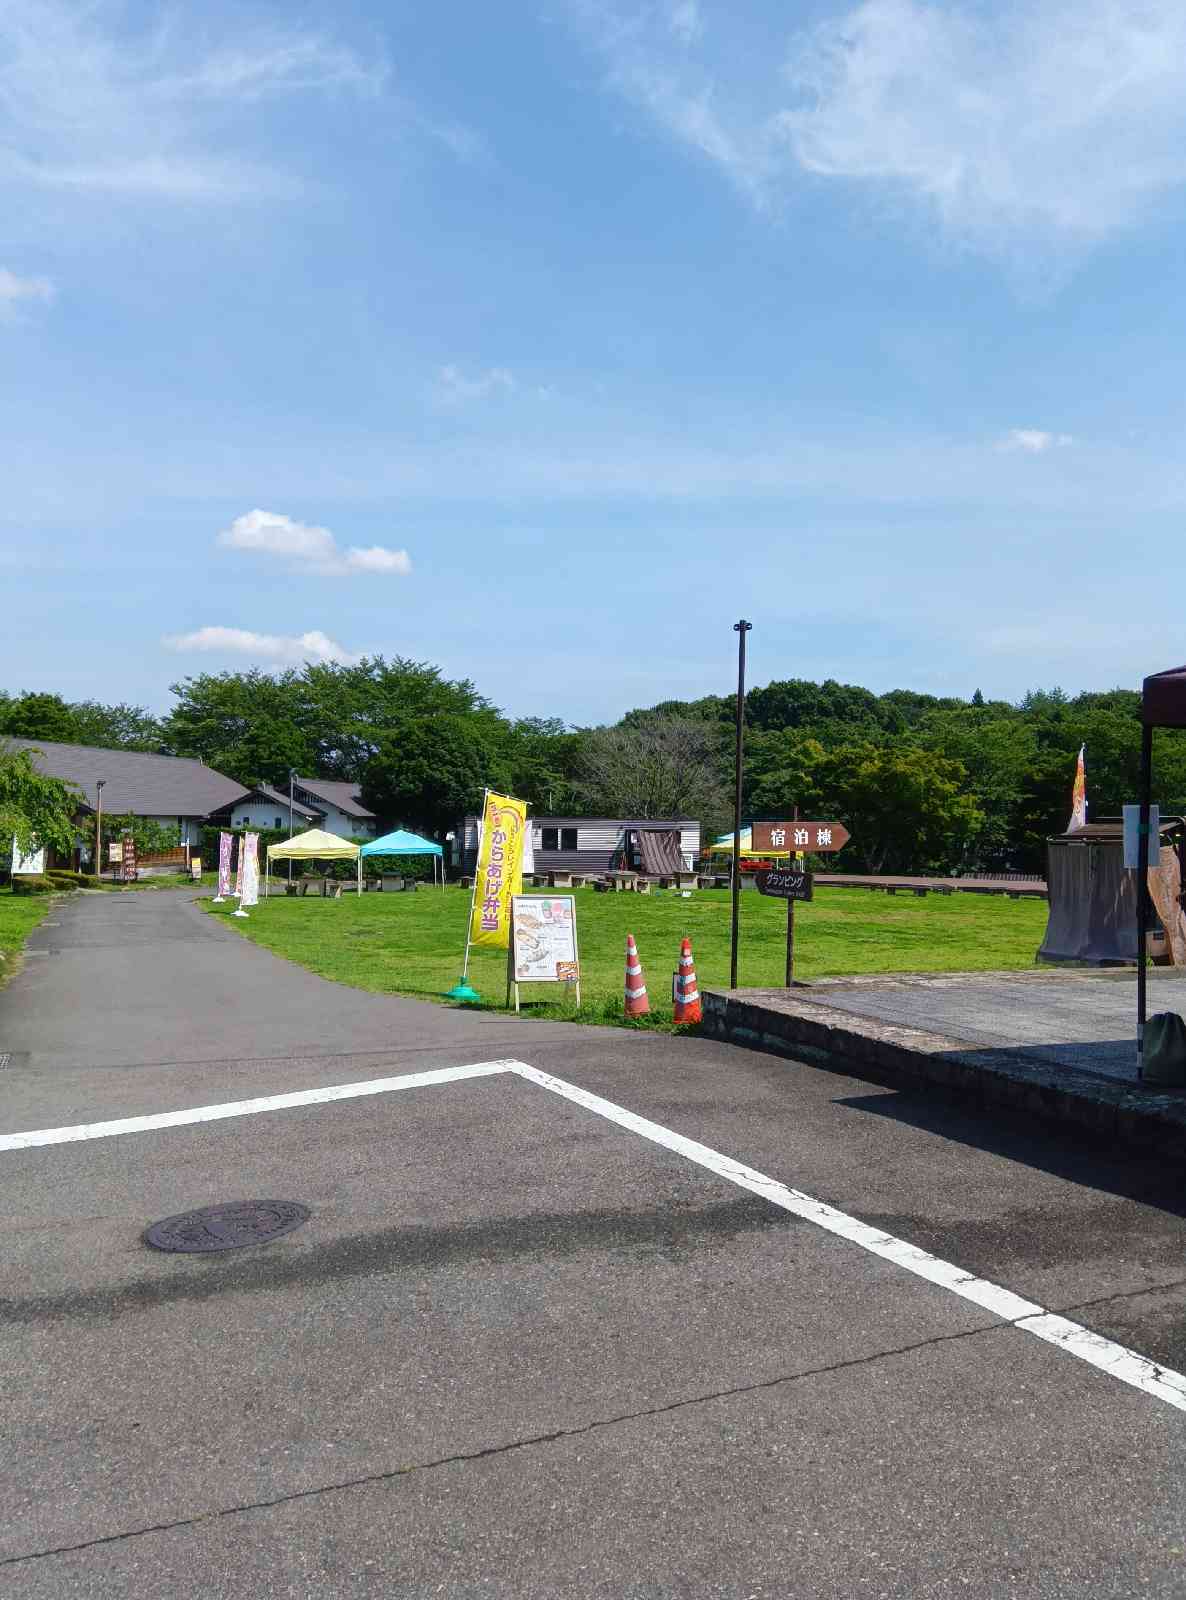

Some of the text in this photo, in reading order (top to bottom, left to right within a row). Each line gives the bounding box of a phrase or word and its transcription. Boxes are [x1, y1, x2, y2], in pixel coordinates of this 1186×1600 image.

[770, 828, 832, 846] 宿泊棟
[481, 830, 507, 931] からあげ弁当
